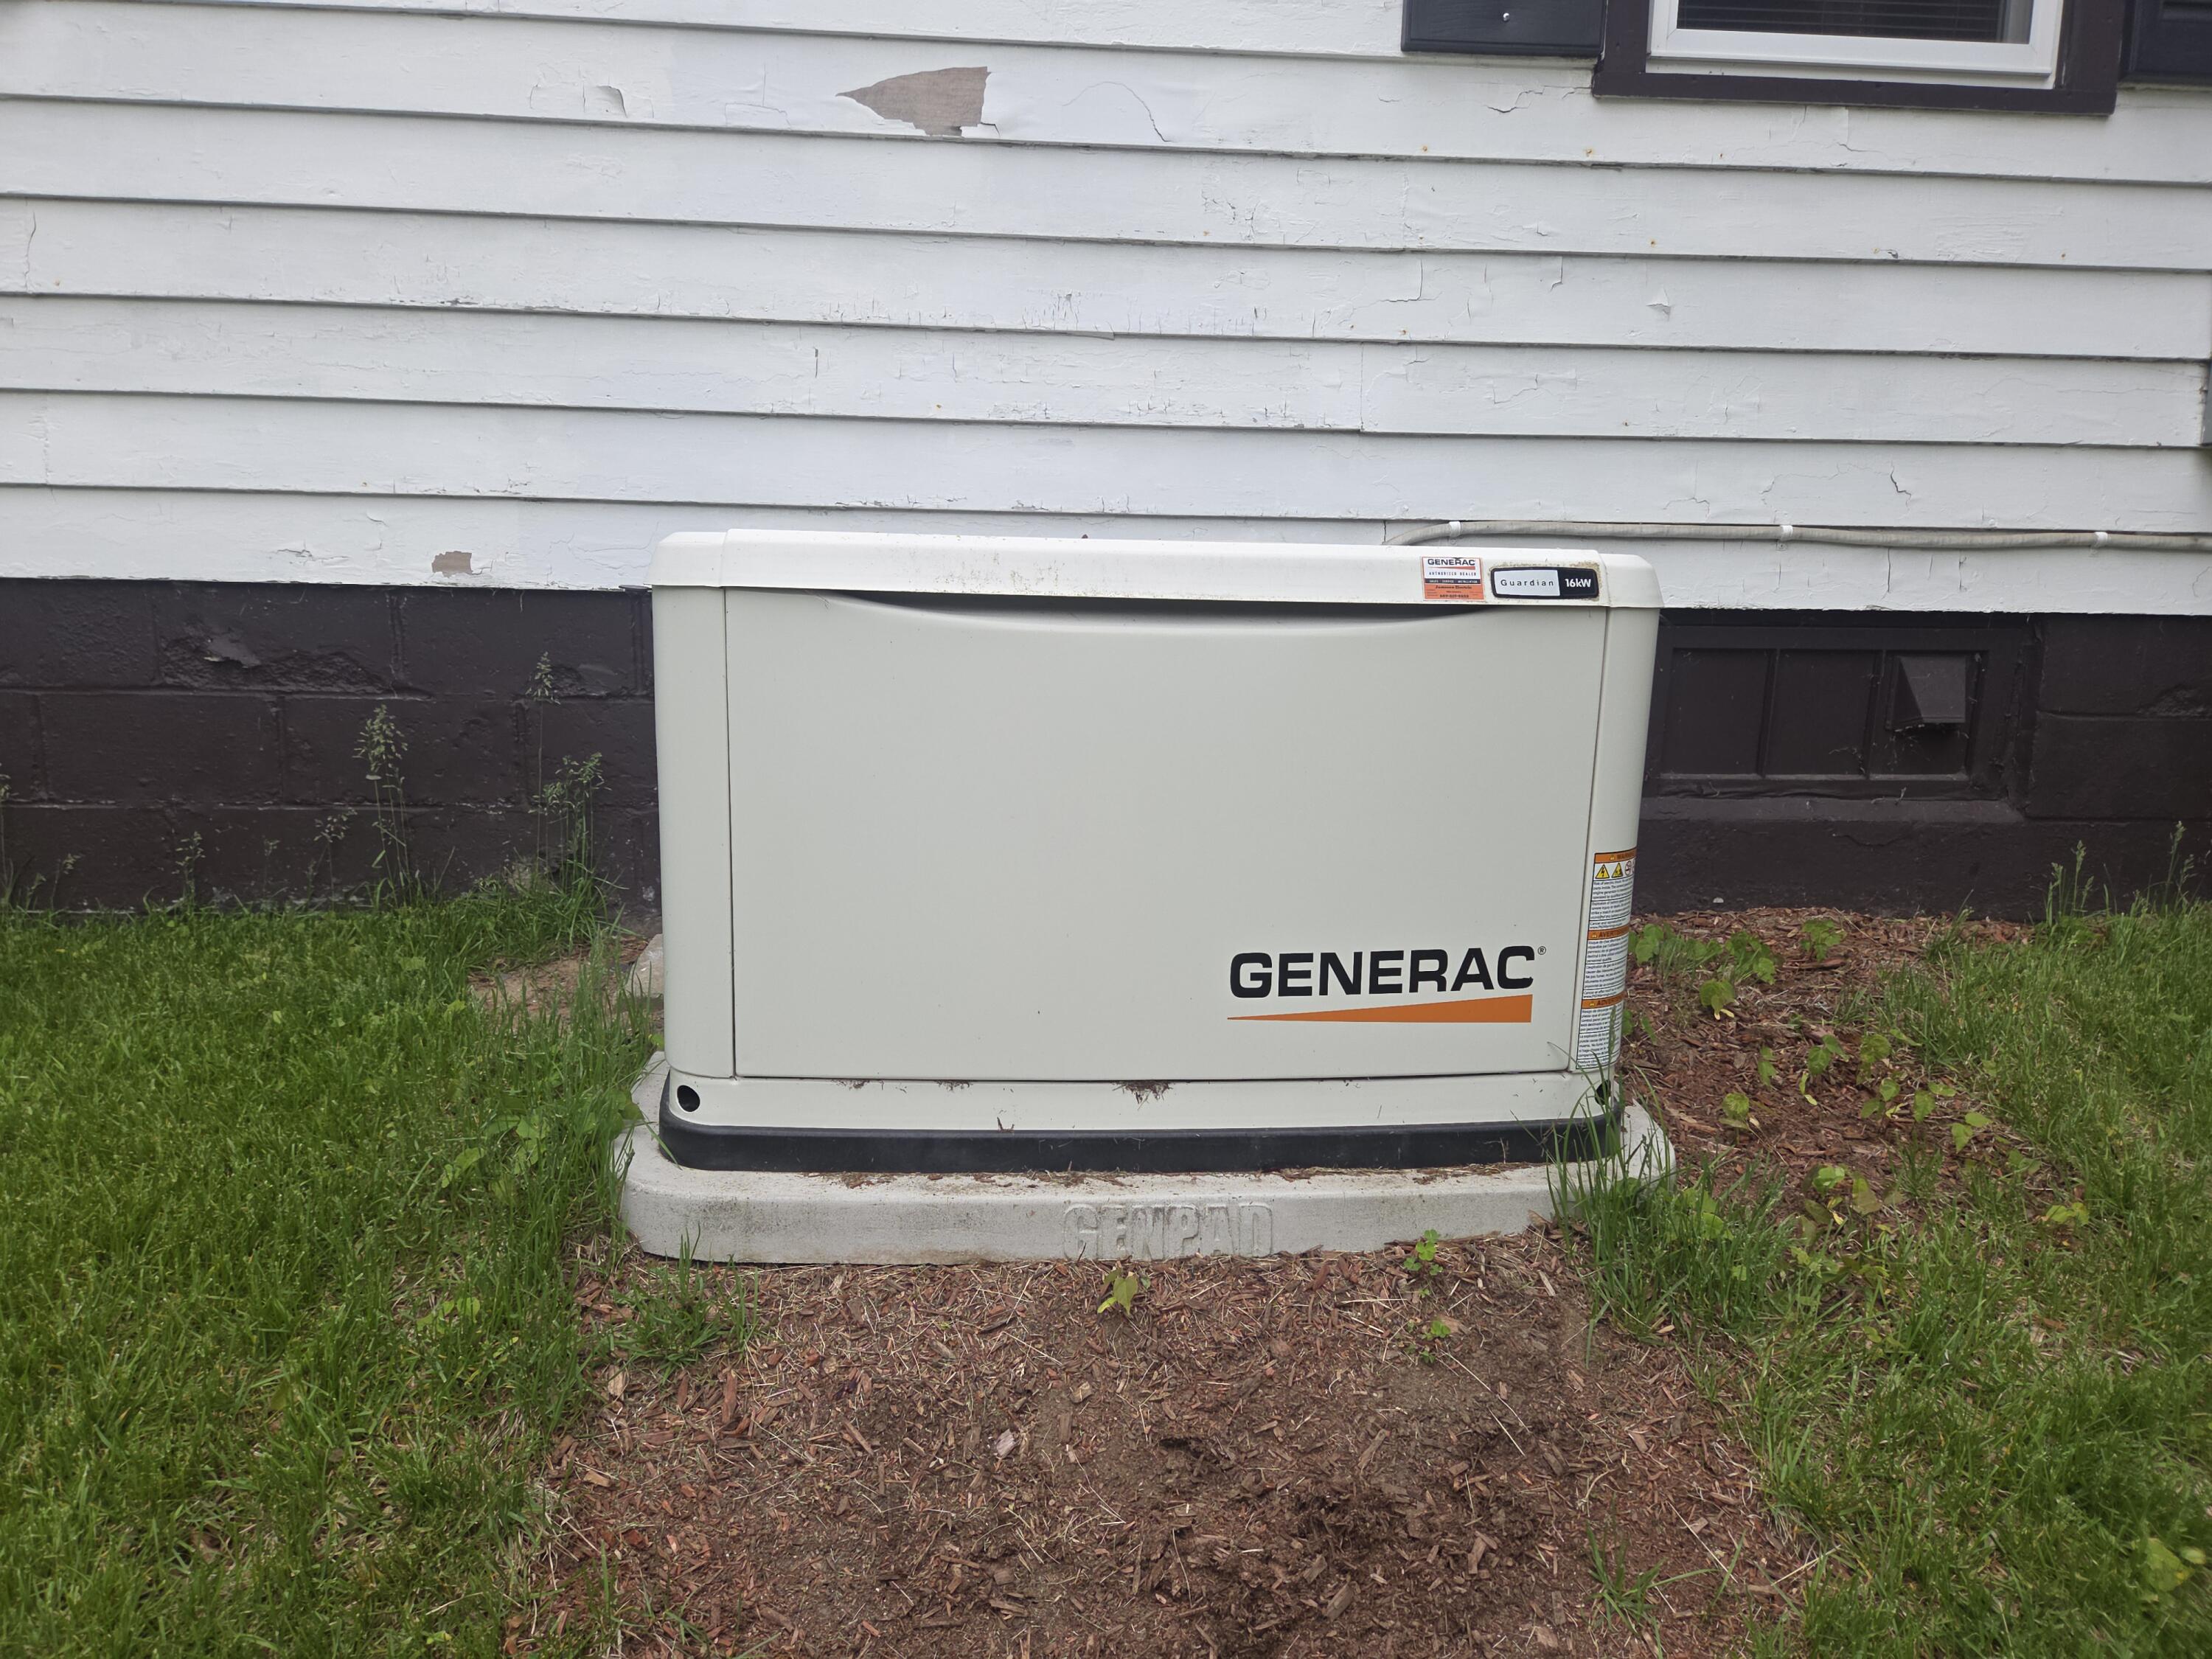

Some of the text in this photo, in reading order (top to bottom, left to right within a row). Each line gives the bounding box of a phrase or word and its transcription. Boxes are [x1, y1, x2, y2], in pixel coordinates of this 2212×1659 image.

[1500, 578, 1591, 588] Guardian 16kW
[1230, 945, 1534, 998] GENERAC
[1064, 1202, 1273, 1262] GENPAD
